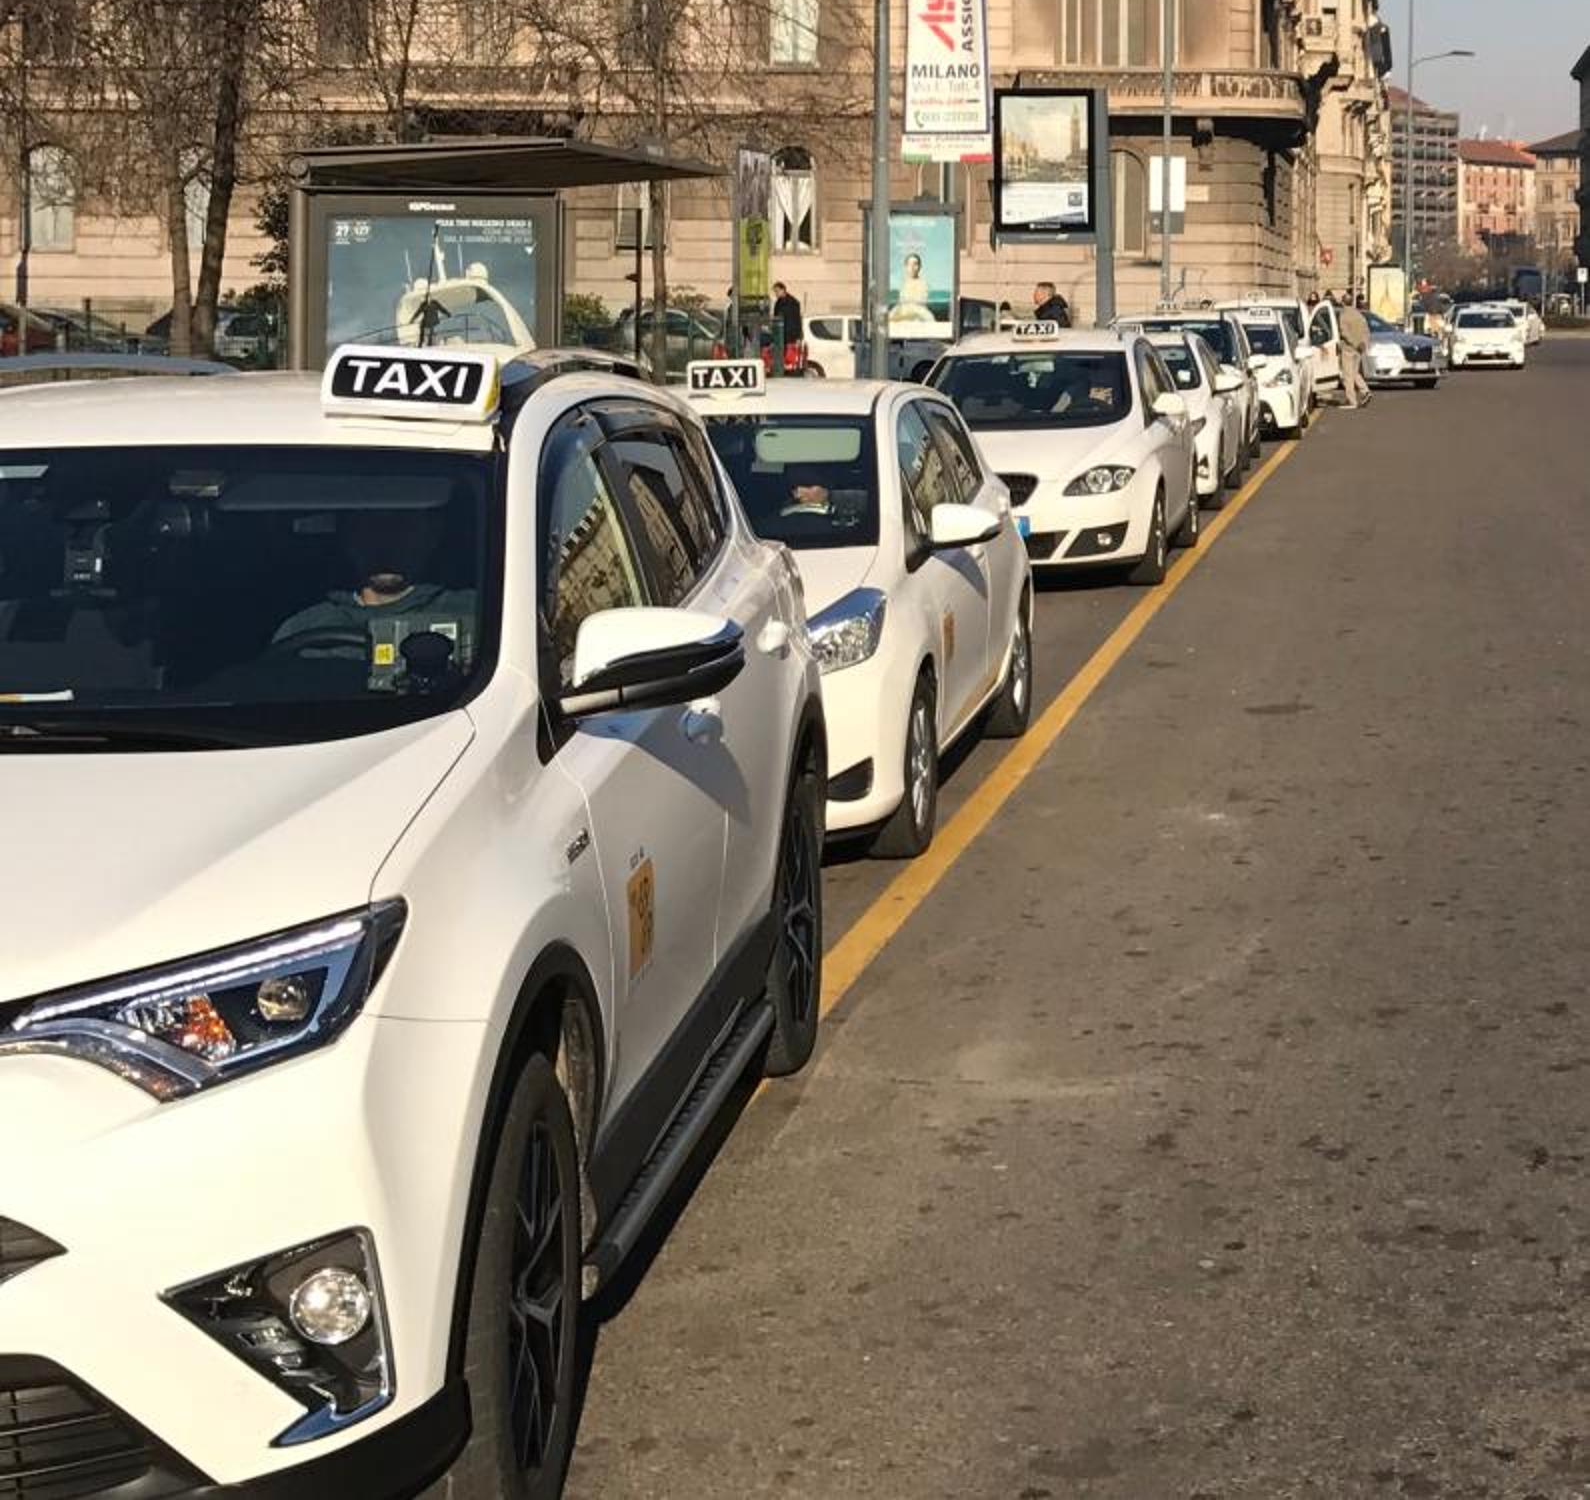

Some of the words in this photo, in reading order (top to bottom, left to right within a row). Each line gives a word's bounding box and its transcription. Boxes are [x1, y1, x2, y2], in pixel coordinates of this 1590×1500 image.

[911, 64, 981, 78] MILANO
[1016, 322, 1054, 335] TAXI
[347, 359, 469, 398] TAXI
[693, 367, 754, 388] TAXI
